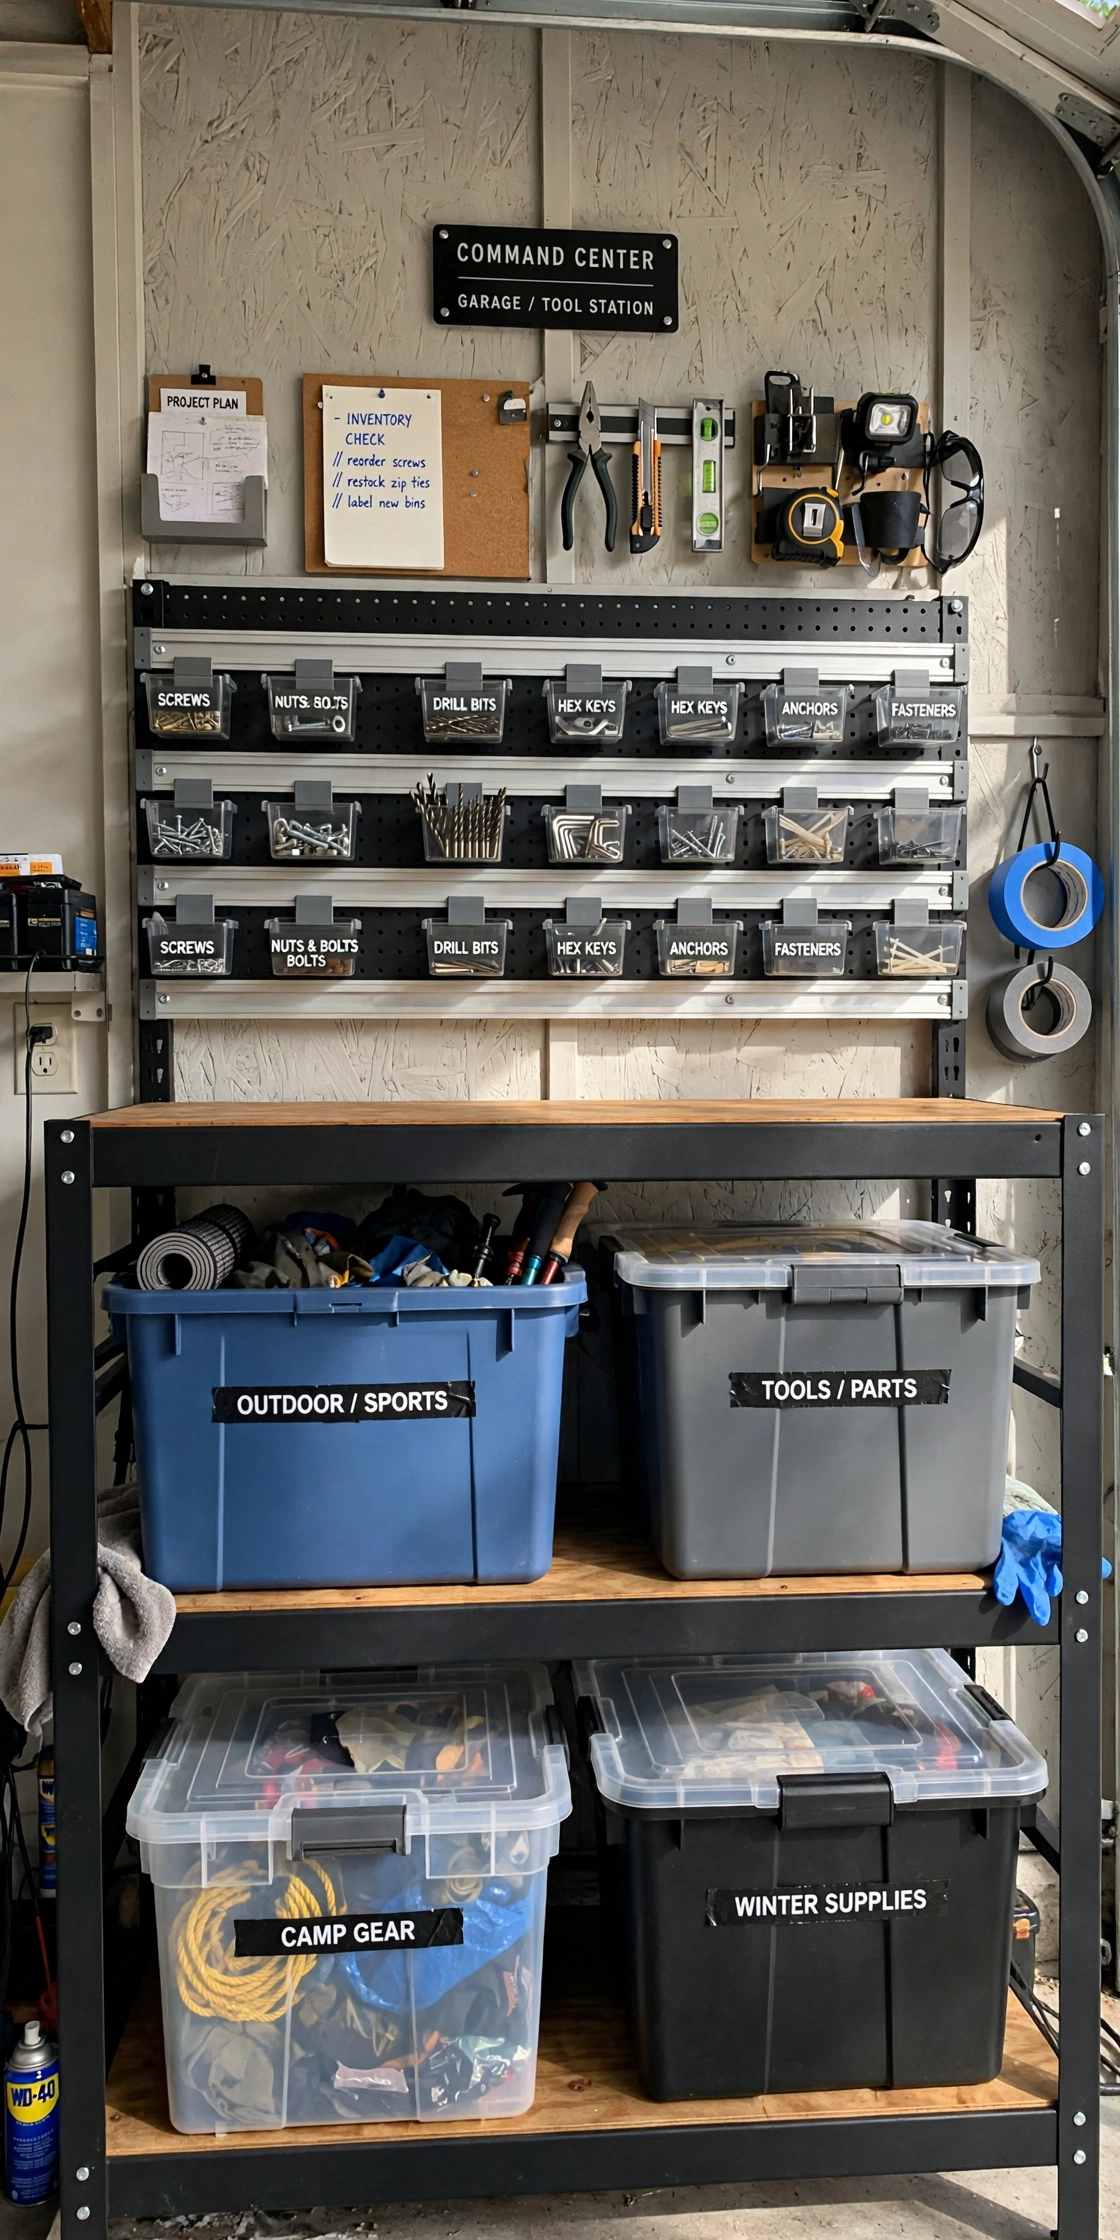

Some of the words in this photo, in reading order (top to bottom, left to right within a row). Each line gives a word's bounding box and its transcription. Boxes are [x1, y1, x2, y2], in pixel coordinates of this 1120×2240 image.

[457, 242, 565, 266] COMMAND
[575, 247, 654, 270] CENTER
[458, 293, 521, 310] GARAGE
[528, 296, 535, 311] /
[542, 297, 582, 313] TOOL
[589, 299, 654, 315] STATION
[167, 396, 210, 408] PROJECT
[213, 398, 239, 409] PLAN
[346, 413, 412, 428] INVENTORY
[345, 433, 385, 446] CHECK
[347, 454, 386, 467] reorder
[393, 457, 426, 469] screws
[347, 475, 385, 488] restock
[391, 477, 407, 492] zip
[411, 476, 430, 488] ties
[348, 495, 372, 508] label
[379, 499, 399, 508] new
[405, 496, 425, 509] bins
[157, 693, 210, 707] SCREWS
[433, 697, 468, 712] DRILL
[471, 698, 497, 711] BITS
[558, 698, 582, 713] HEX
[586, 699, 616, 713] KEYS
[671, 700, 694, 714] HEX
[697, 700, 728, 714] KEYS
[782, 702, 838, 716] ANCHORS
[892, 703, 956, 717] FASTENERS
[160, 940, 215, 955] SCREWS
[271, 939, 304, 953] NUTS
[307, 939, 317, 951] &
[320, 939, 359, 953] BOLTS
[433, 940, 469, 955] DRILL
[472, 940, 499, 955] BITS
[557, 941, 581, 955] HEX
[585, 941, 617, 955] KEYS
[669, 941, 728, 956] ANCHORS
[774, 942, 841, 957] FASTENERS
[287, 954, 326, 968] BOLTS
[761, 1379, 831, 1400] TOOLS
[836, 1379, 845, 1400] /
[851, 1378, 917, 1399] PARTS
[236, 1393, 344, 1415] OUTDOOR
[350, 1393, 358, 1414] /
[364, 1390, 448, 1413] SPORTS
[734, 1894, 819, 1917] WINTER
[824, 1889, 927, 1914] SUPPLIES
[281, 1924, 347, 1948] CAMP
[353, 1920, 415, 1943] GEAR
